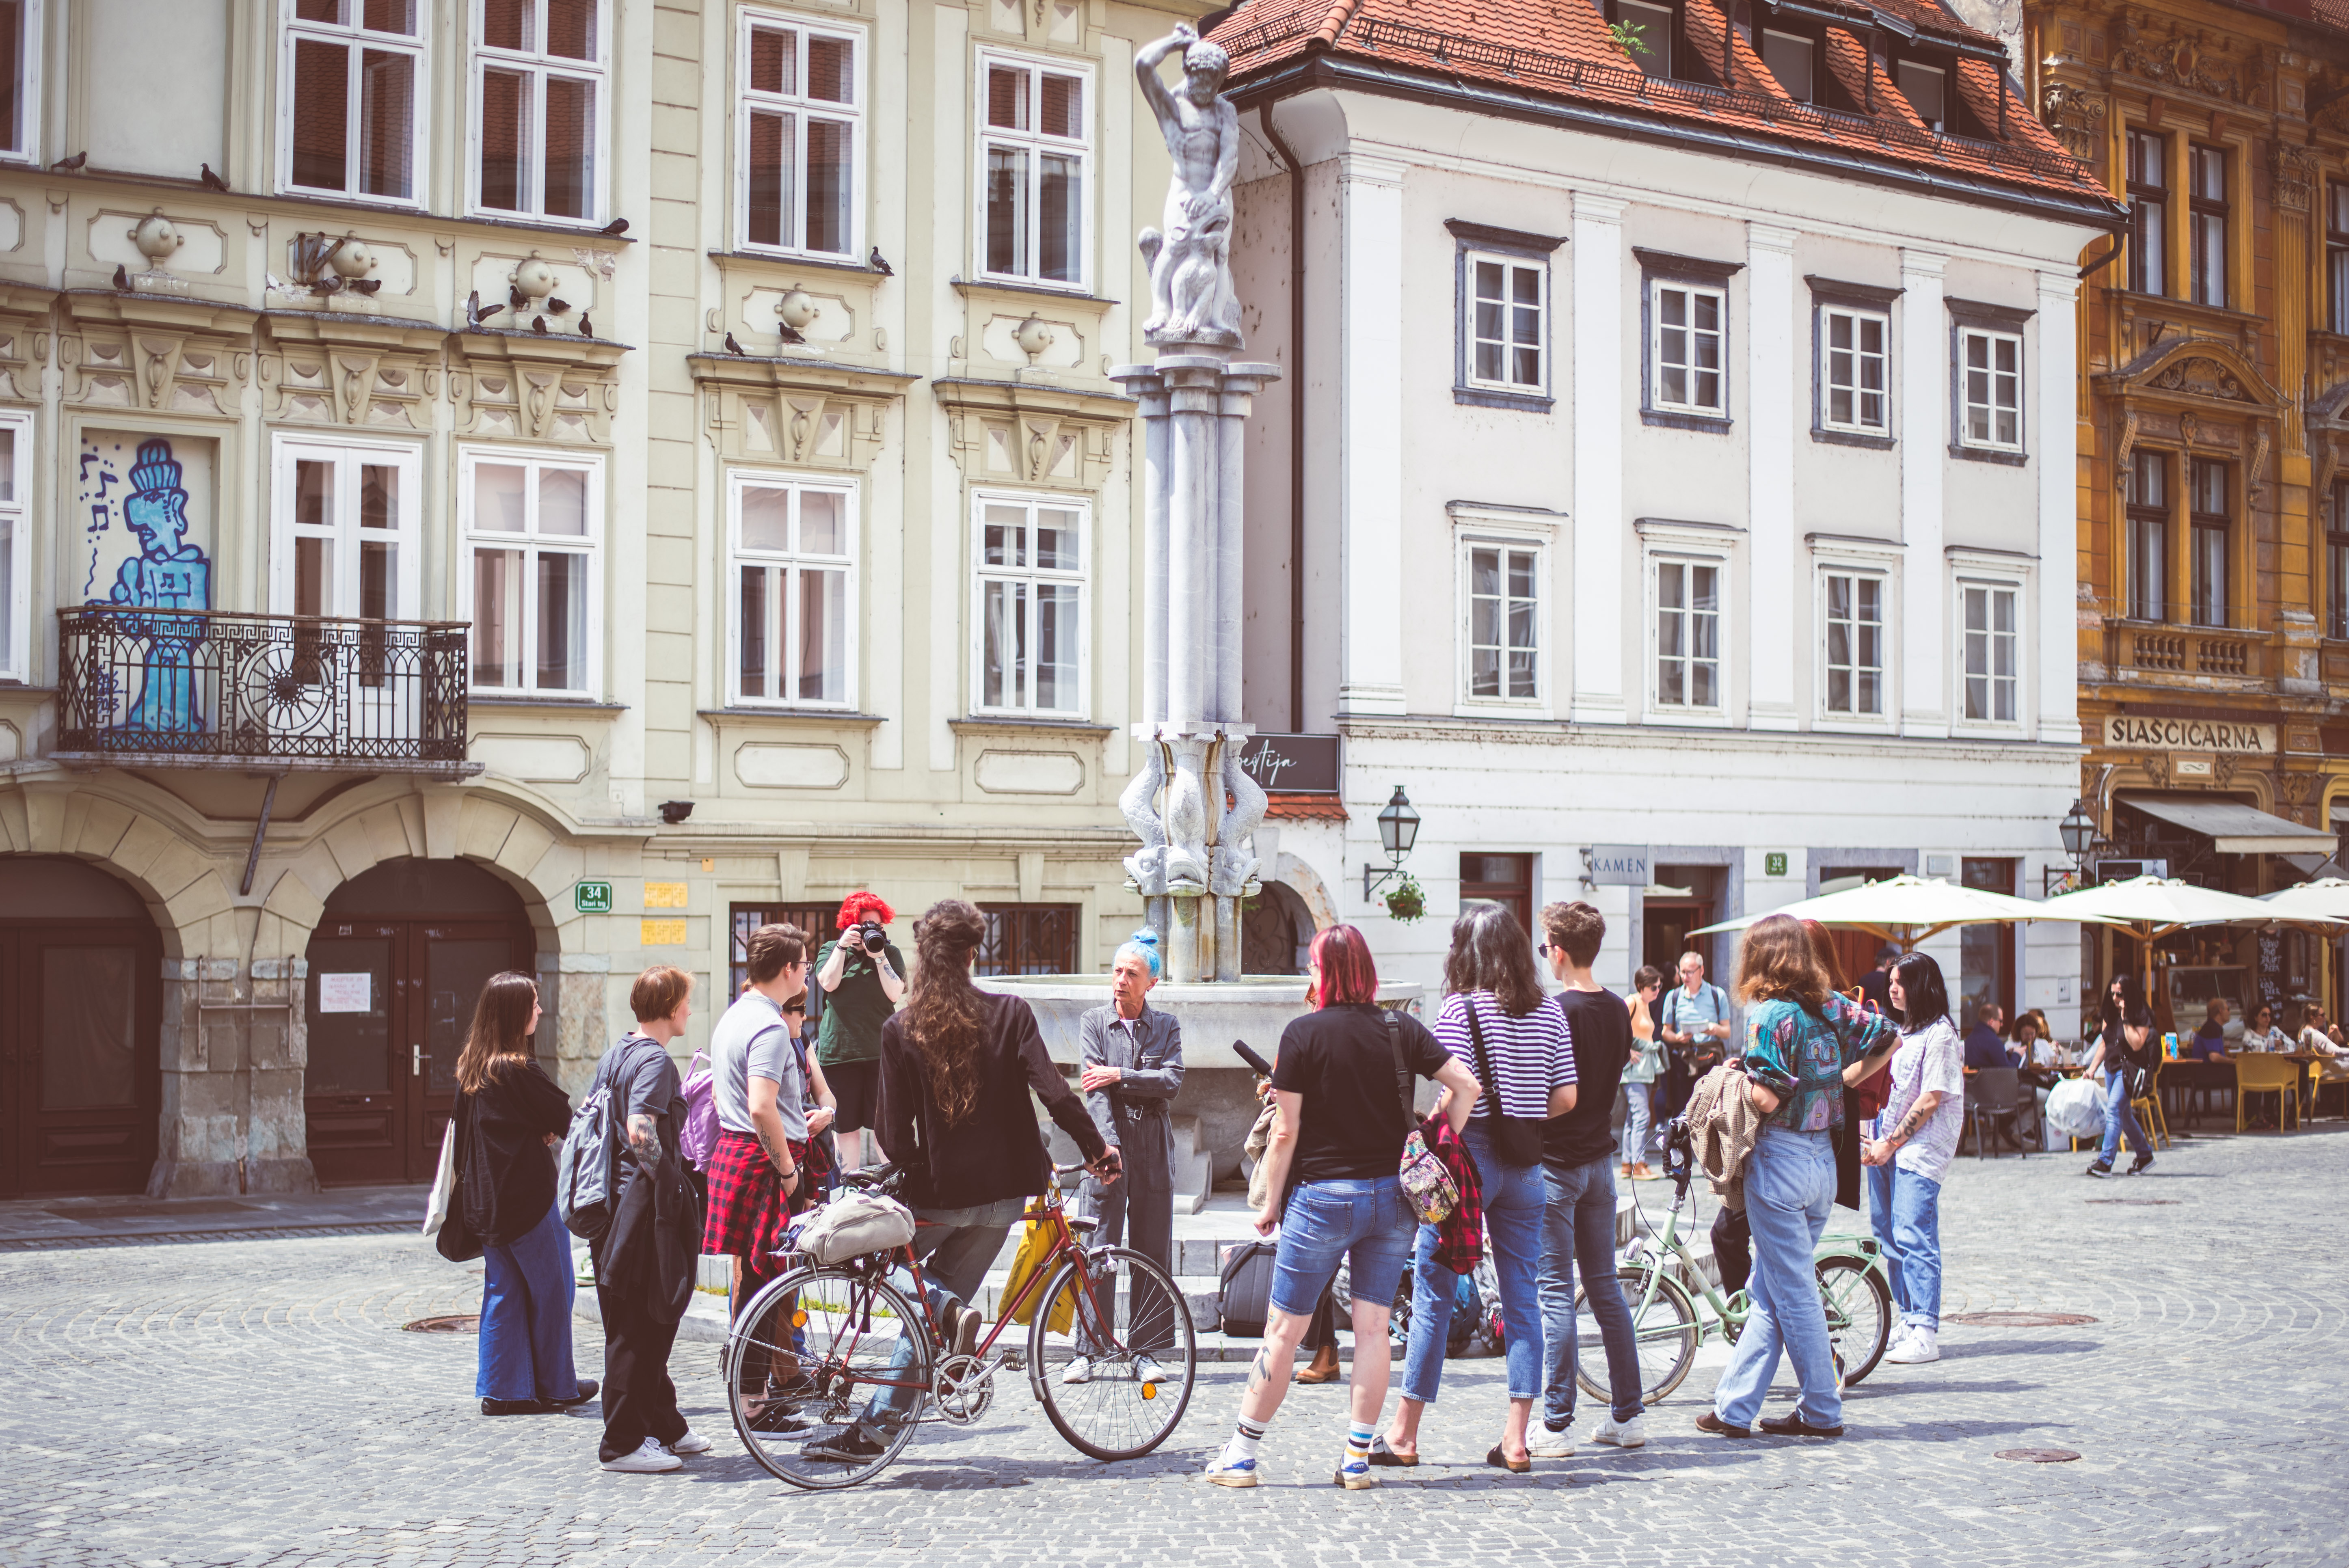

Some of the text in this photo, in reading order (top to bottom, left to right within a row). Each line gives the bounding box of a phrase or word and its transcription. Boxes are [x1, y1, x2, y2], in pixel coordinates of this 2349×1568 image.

[2111, 718, 2262, 750] SLAŠČIČARNA
[1594, 857, 1646, 874] KAMEN
[1772, 855, 1783, 867] 32
[587, 886, 601, 899] 34
[581, 899, 606, 908] Stari trg
